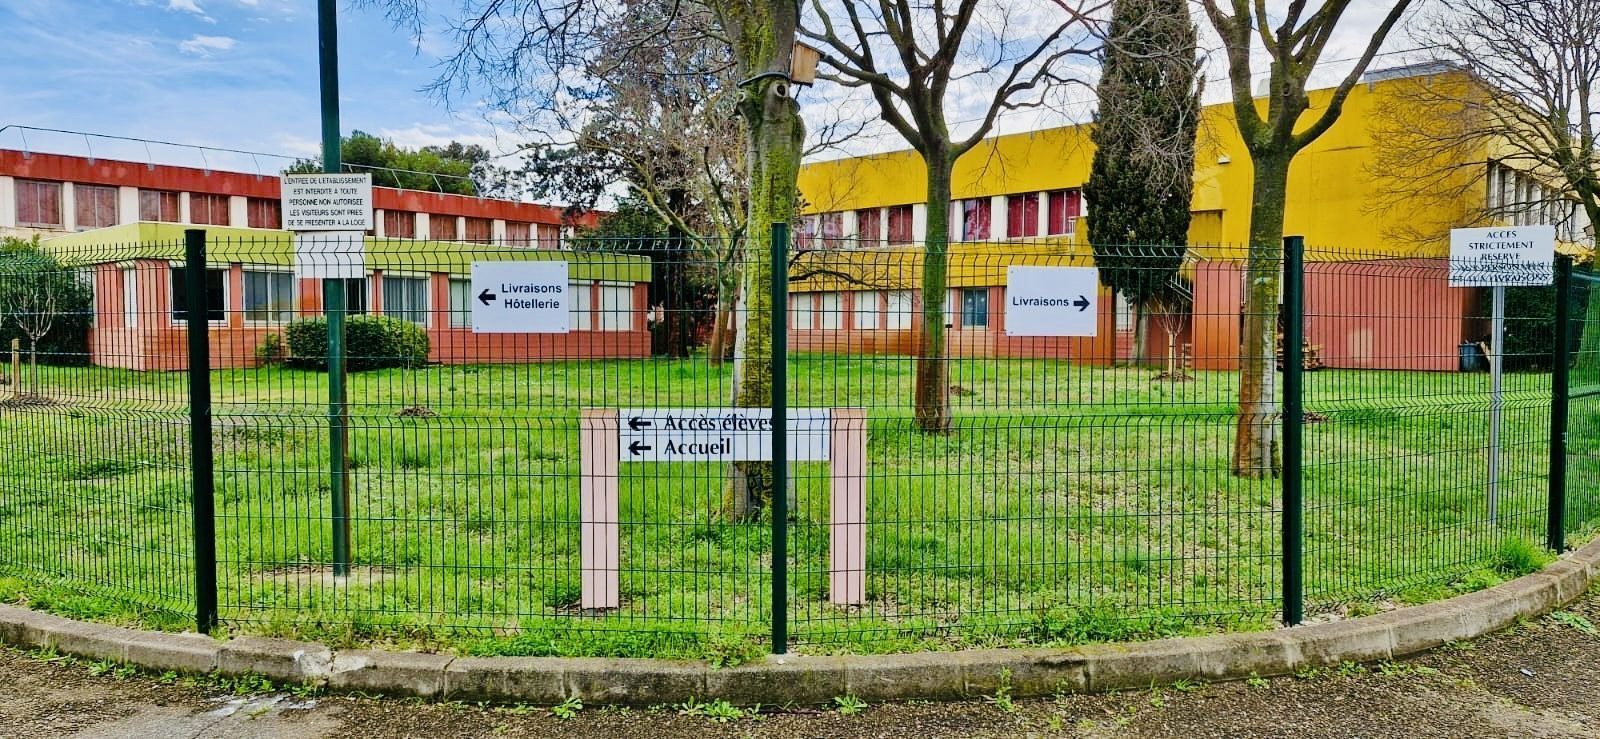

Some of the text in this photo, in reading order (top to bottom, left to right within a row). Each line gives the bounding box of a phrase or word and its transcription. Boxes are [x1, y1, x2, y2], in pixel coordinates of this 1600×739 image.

[289, 198, 364, 206] PERSONNE NON AUTORISEE
[1487, 230, 1517, 239] ACCES
[1468, 241, 1534, 250] STRICTEMENT
[1481, 252, 1521, 261] RESERVE
[501, 283, 562, 293] Livraisons
[504, 298, 560, 309] Hôtellerie
[1012, 295, 1069, 307] Livraisons
[664, 413, 716, 431] Accès
[664, 438, 730, 455] Accueil
